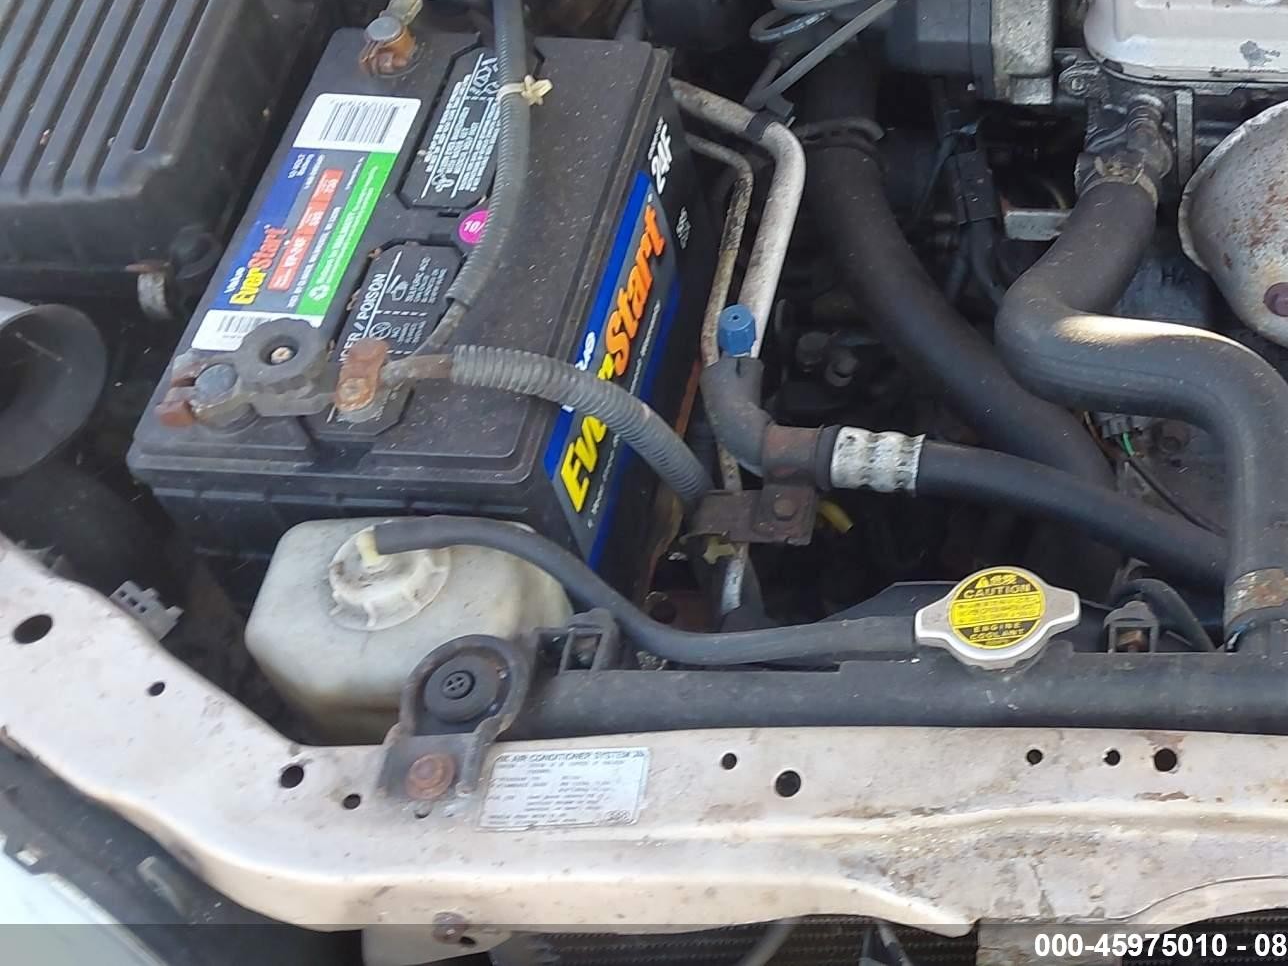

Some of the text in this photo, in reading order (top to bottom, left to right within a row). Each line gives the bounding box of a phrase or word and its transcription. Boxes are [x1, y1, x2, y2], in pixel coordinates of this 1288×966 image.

[229, 227, 288, 306] EverStart
[355, 272, 388, 321] POISON
[963, 583, 1032, 599] CAUTION
[973, 622, 1021, 634] ENGINE
